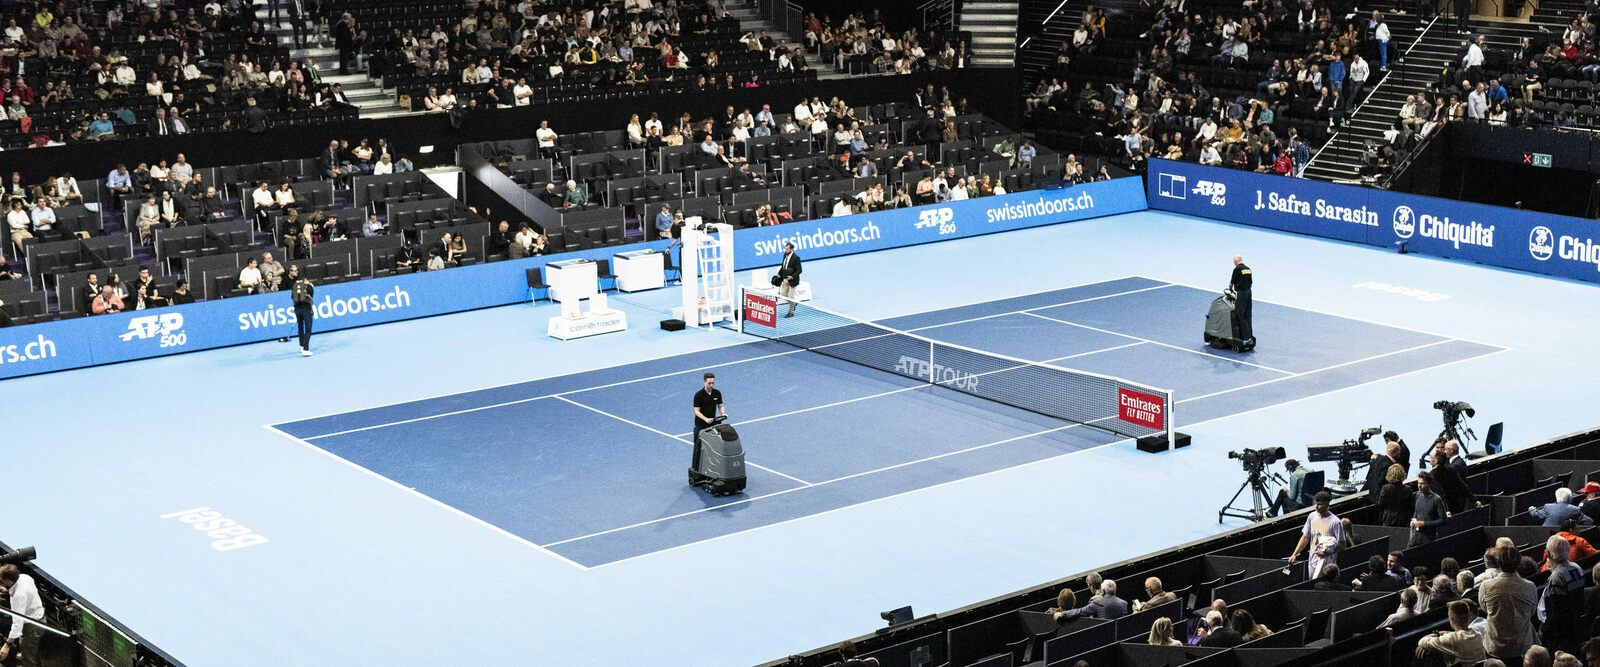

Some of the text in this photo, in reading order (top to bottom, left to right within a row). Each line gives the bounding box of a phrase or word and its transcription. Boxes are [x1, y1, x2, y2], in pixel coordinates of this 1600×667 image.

[1191, 180, 1226, 196] ATP
[1211, 196, 1226, 206] 500
[914, 207, 954, 229] ATP
[986, 191, 1094, 223] swissindoors.ch
[1254, 190, 1379, 226] J. Safra Sarasin
[754, 221, 881, 256] swissindoors.ch
[939, 223, 957, 235] 500
[1420, 214, 1494, 249] Chiquita
[1559, 235, 1600, 272] Chiq
[238, 285, 411, 330] swissdoors.ch
[747, 299, 775, 315] Emirates
[118, 312, 184, 341] ATP
[160, 333, 187, 348] 500
[894, 355, 979, 393] ATP TOUR
[1121, 393, 1161, 414] Emirates
[1126, 407, 1155, 423] FLY BETTER
[159, 506, 271, 552] Basel
